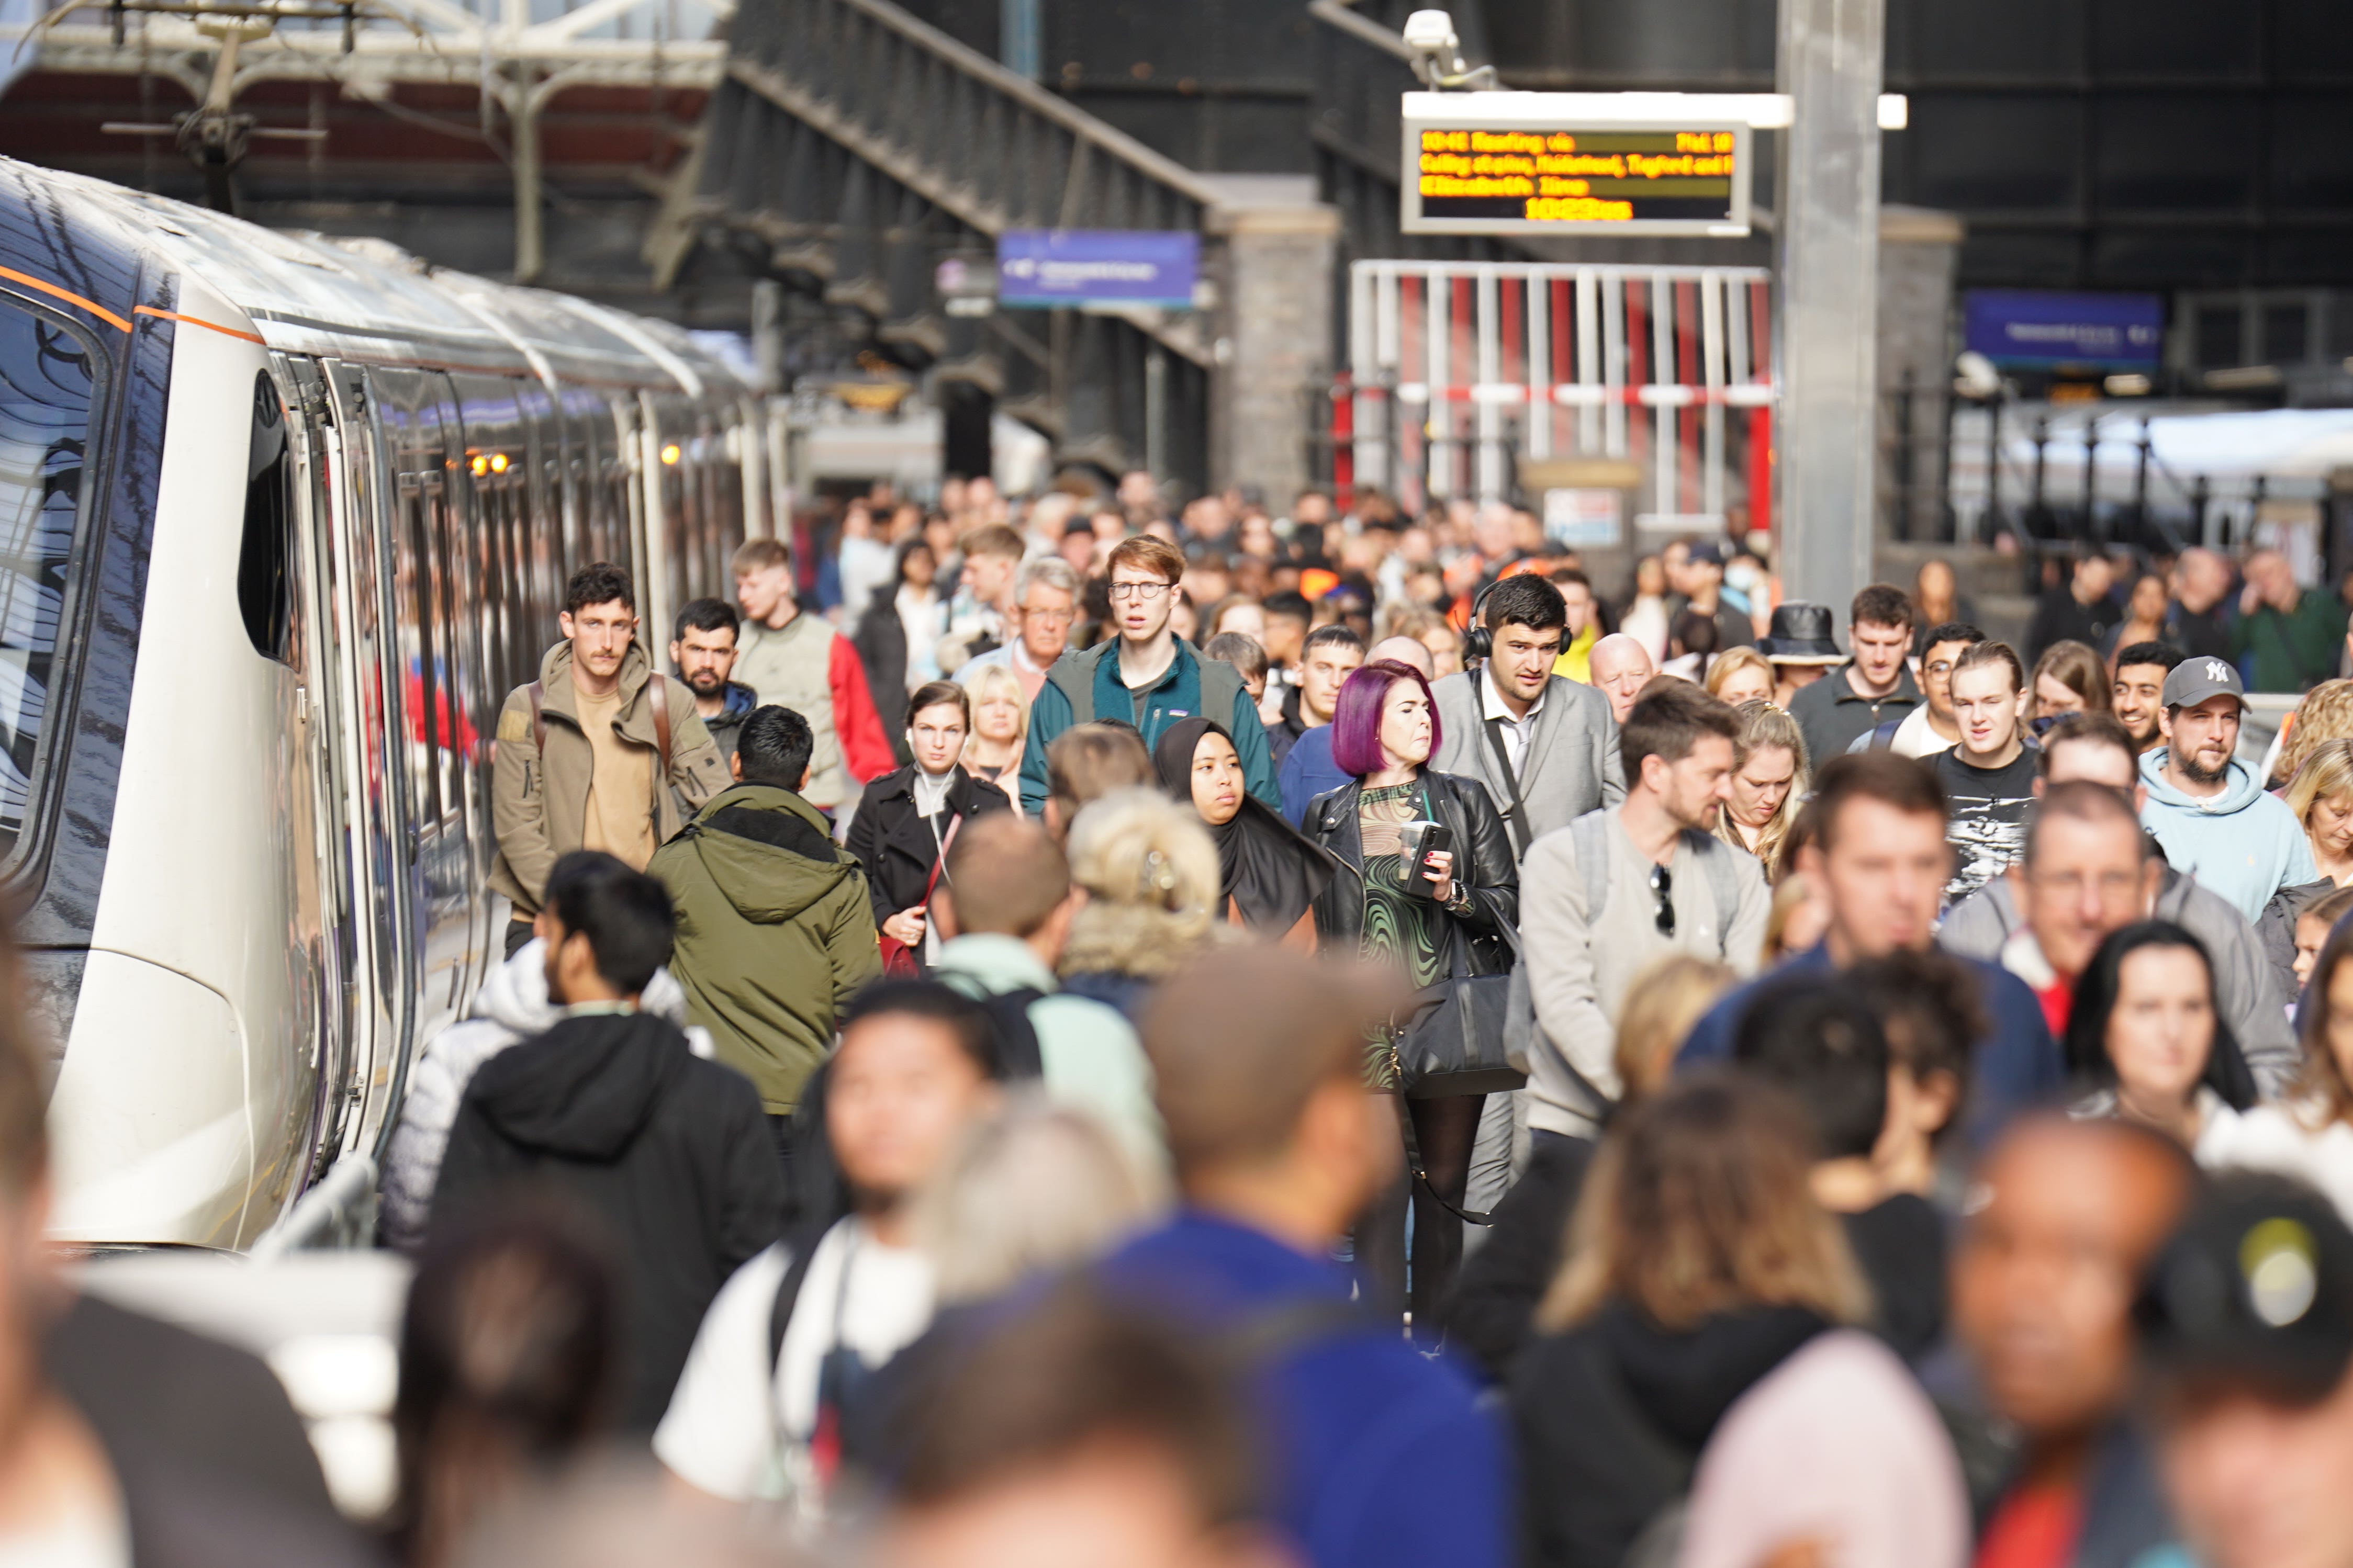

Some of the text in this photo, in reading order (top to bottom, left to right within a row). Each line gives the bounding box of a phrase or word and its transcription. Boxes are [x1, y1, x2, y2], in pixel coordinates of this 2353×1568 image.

[1471, 131, 1546, 155] Reading
[1627, 154, 1693, 177] Twyford
[1419, 175, 1534, 197] Elizabeth
[2205, 661, 2229, 682] NY
